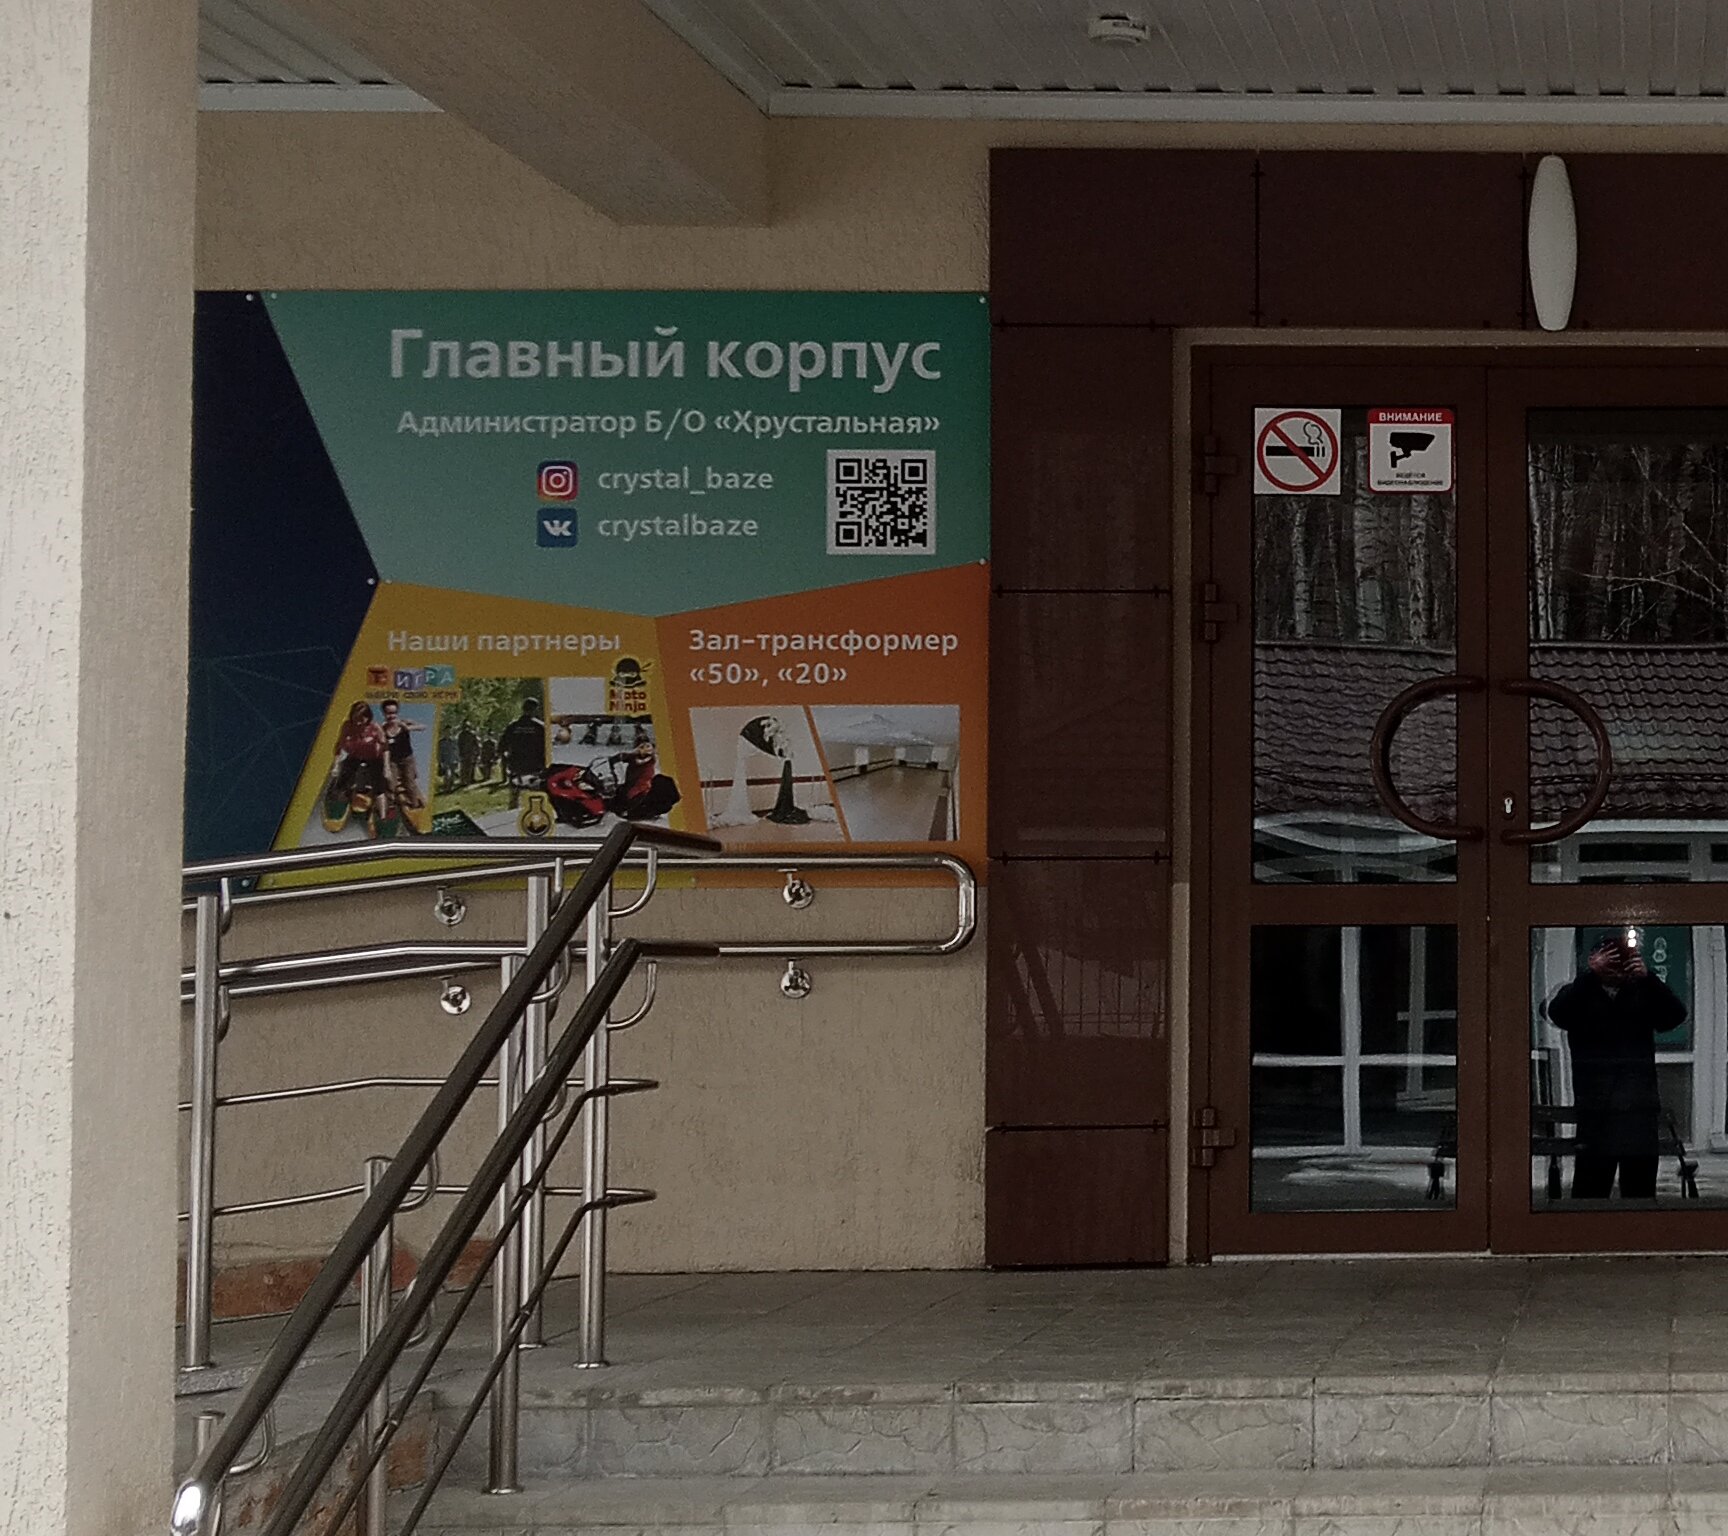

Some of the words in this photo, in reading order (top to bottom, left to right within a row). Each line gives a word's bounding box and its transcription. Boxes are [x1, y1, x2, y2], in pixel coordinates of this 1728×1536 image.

[391, 326, 685, 379] Главный
[707, 340, 942, 394] корпус
[398, 410, 637, 439] Администратор
[645, 408, 705, 441] Б/О
[714, 409, 940, 440] «Хрустальная»
[1378, 411, 1443, 423] ВНИМАНИЕ
[598, 466, 774, 495] crystal_baze
[598, 513, 759, 542] crystalbaze
[387, 630, 469, 652] Наши
[477, 632, 622, 657] партнеры
[688, 629, 959, 657] Зал-трансформер
[689, 662, 769, 688] «50»,
[777, 662, 848, 685] «20»
